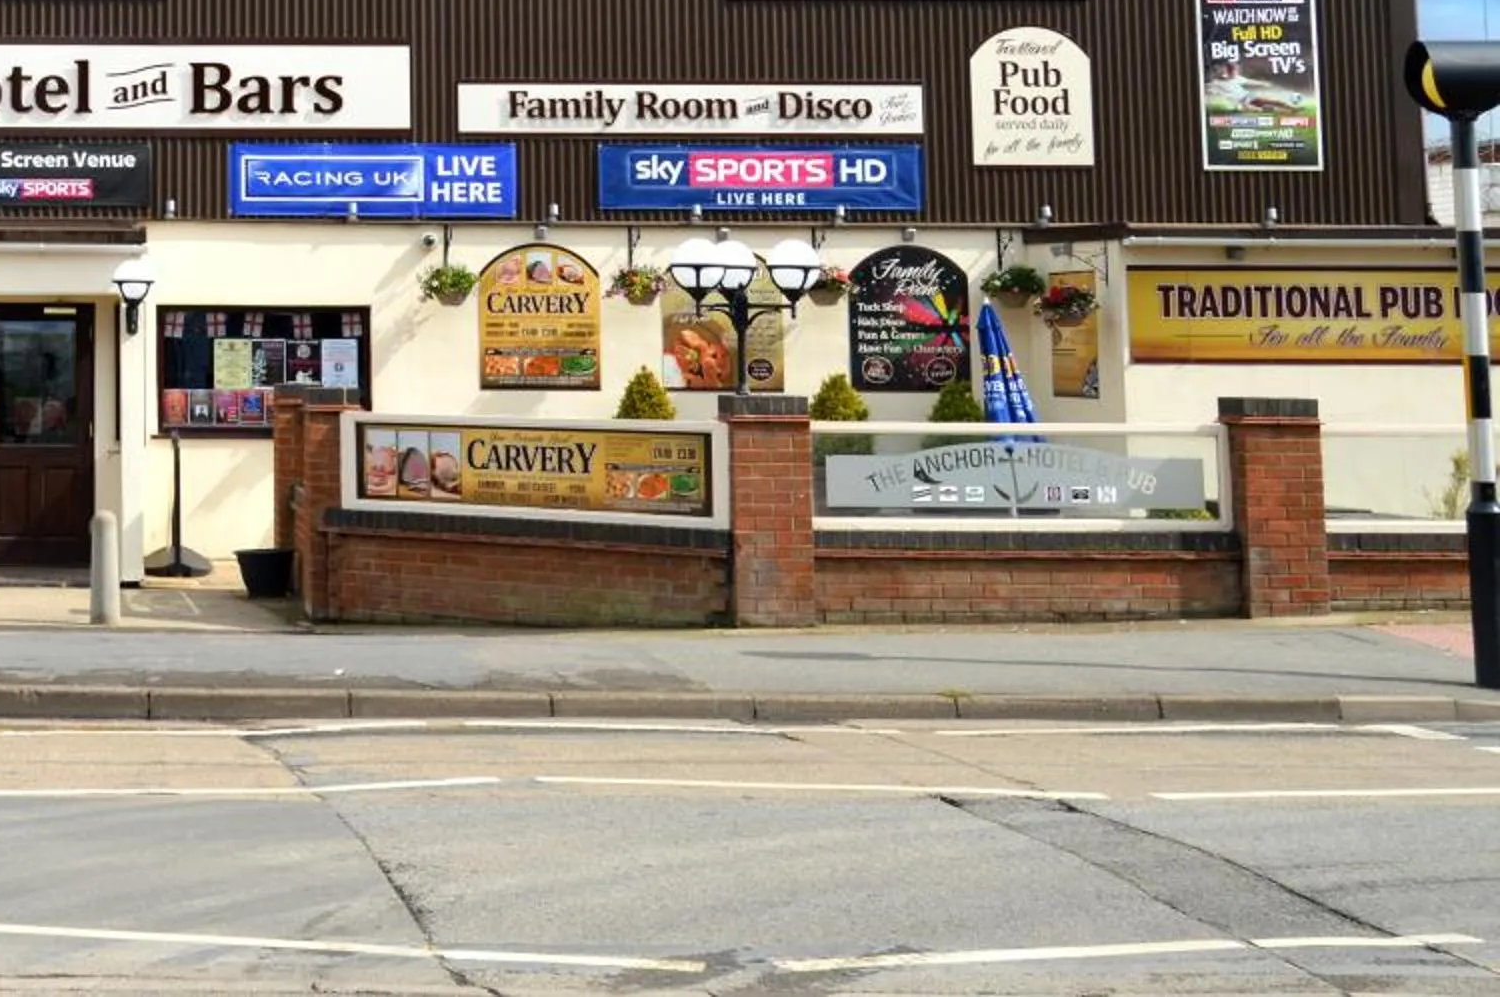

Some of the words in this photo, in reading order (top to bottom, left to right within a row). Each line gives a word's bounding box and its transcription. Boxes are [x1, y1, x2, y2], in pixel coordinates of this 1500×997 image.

[1212, 8, 1255, 24] WATCH
[1257, 7, 1287, 23] NOW
[1231, 25, 1257, 41] Full
[1260, 25, 1284, 40] HD
[1211, 41, 1239, 63] Big
[1243, 41, 1301, 58] Screen
[999, 60, 1063, 88] Pub
[1268, 57, 1306, 74] TV's
[112, 70, 169, 105] and
[189, 61, 344, 114] Bars
[508, 90, 626, 126] Family
[635, 91, 739, 120] Room
[745, 98, 770, 115] and
[777, 91, 874, 120] Disco
[992, 88, 1071, 116] Food
[995, 119, 1037, 131] served
[1039, 118, 1069, 133] daily
[1, 151, 69, 168] Screen
[73, 150, 137, 168] Venue
[435, 155, 497, 176] LIVE
[635, 154, 685, 185] sky
[694, 157, 827, 184] SPORTS
[839, 158, 888, 184] HD
[253, 170, 364, 186] RACING
[373, 171, 413, 186] UK
[22, 181, 91, 197] SPORTS
[430, 182, 502, 203] HERE
[716, 192, 755, 205] LIVE
[761, 192, 806, 206] HERE
[871, 258, 945, 284] Family
[486, 291, 590, 314] CARVERY
[857, 302, 880, 312] Tuck
[1156, 284, 1372, 318] TRADITIONAL
[1380, 285, 1445, 319] PUB
[857, 330, 877, 340] Fun
[880, 330, 890, 340] &
[1295, 324, 1330, 346] all
[857, 344, 882, 354] Have
[466, 439, 597, 475] CARVERY
[865, 463, 907, 492] THE
[913, 447, 996, 478] ANCHOR
